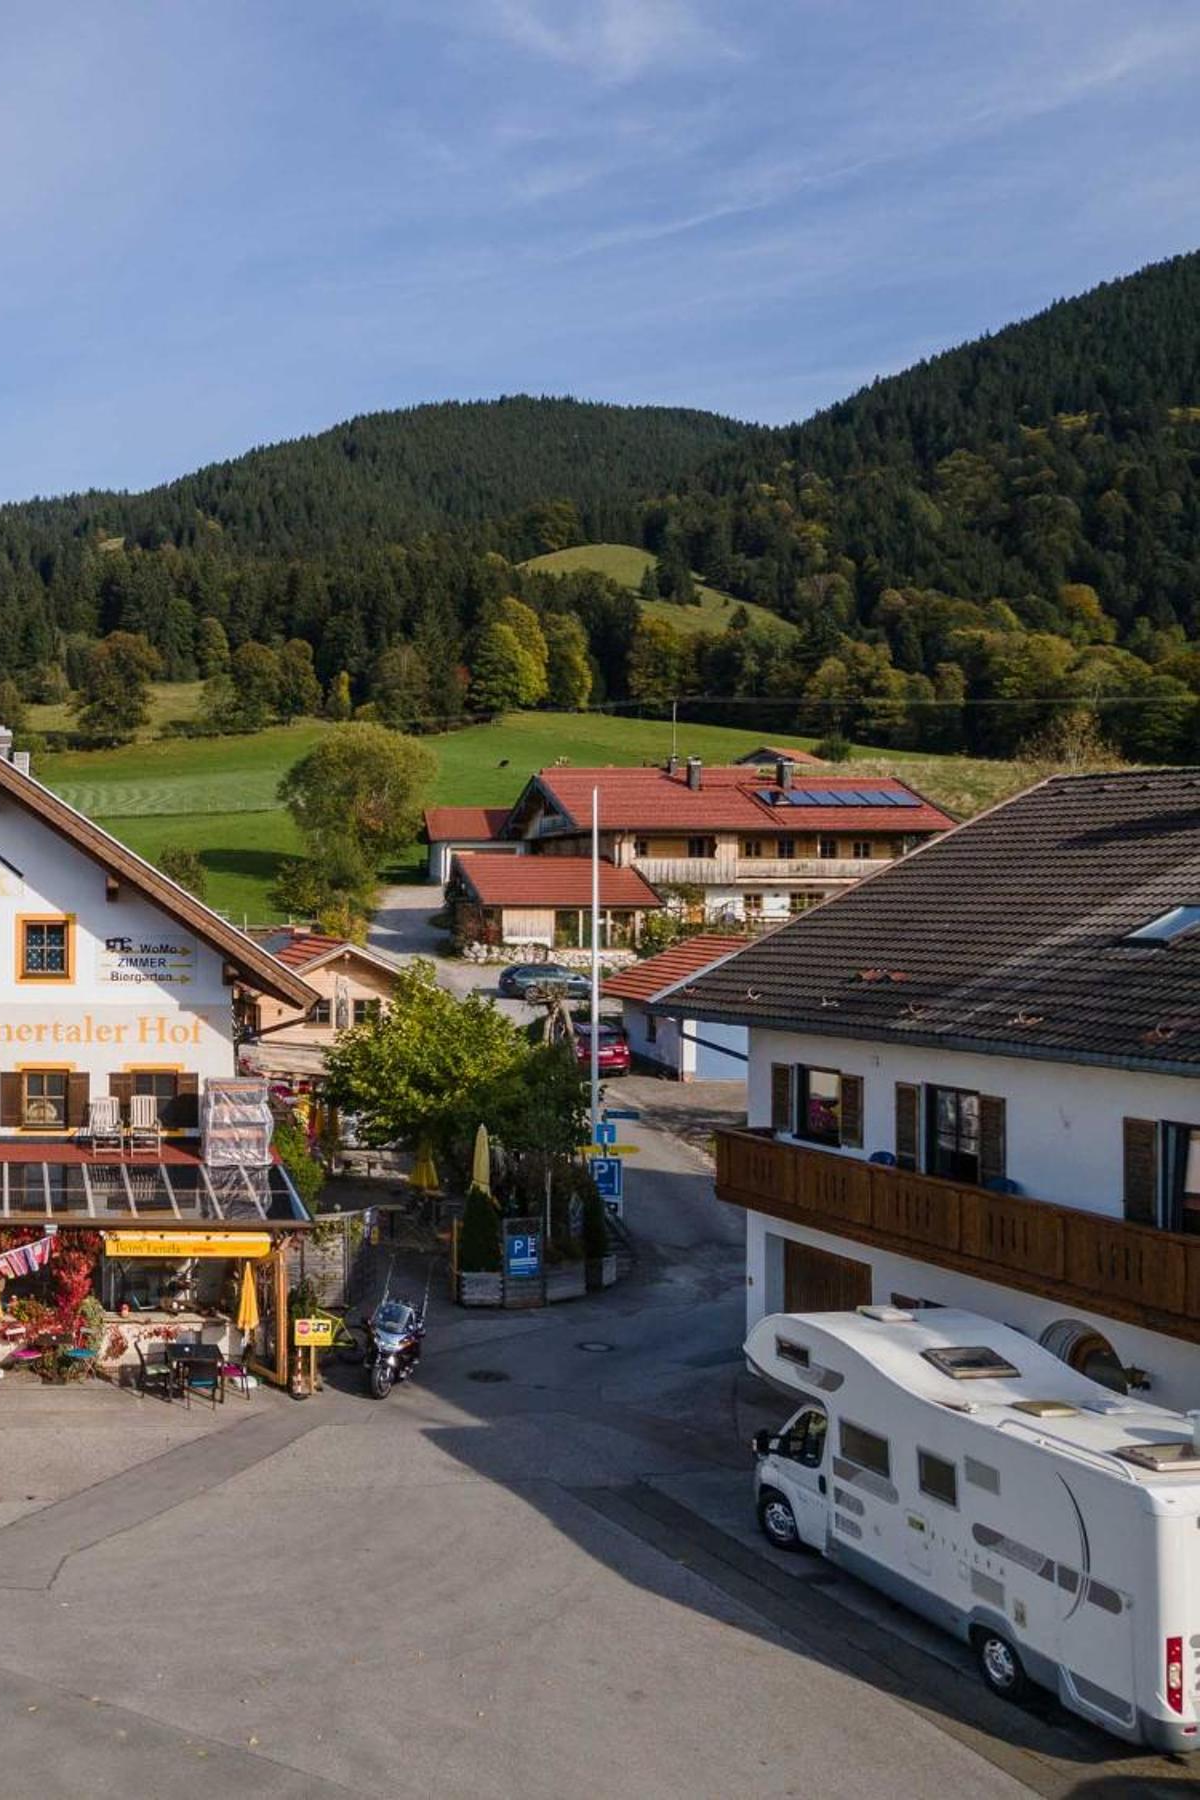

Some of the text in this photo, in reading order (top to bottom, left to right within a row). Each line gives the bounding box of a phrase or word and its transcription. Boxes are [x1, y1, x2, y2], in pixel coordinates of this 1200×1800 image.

[117, 957, 167, 968] ZIMMER
[110, 970, 173, 984] Biergarten
[137, 1014, 209, 1045] Hof
[593, 1160, 609, 1181] P
[514, 1239, 524, 1255] P
